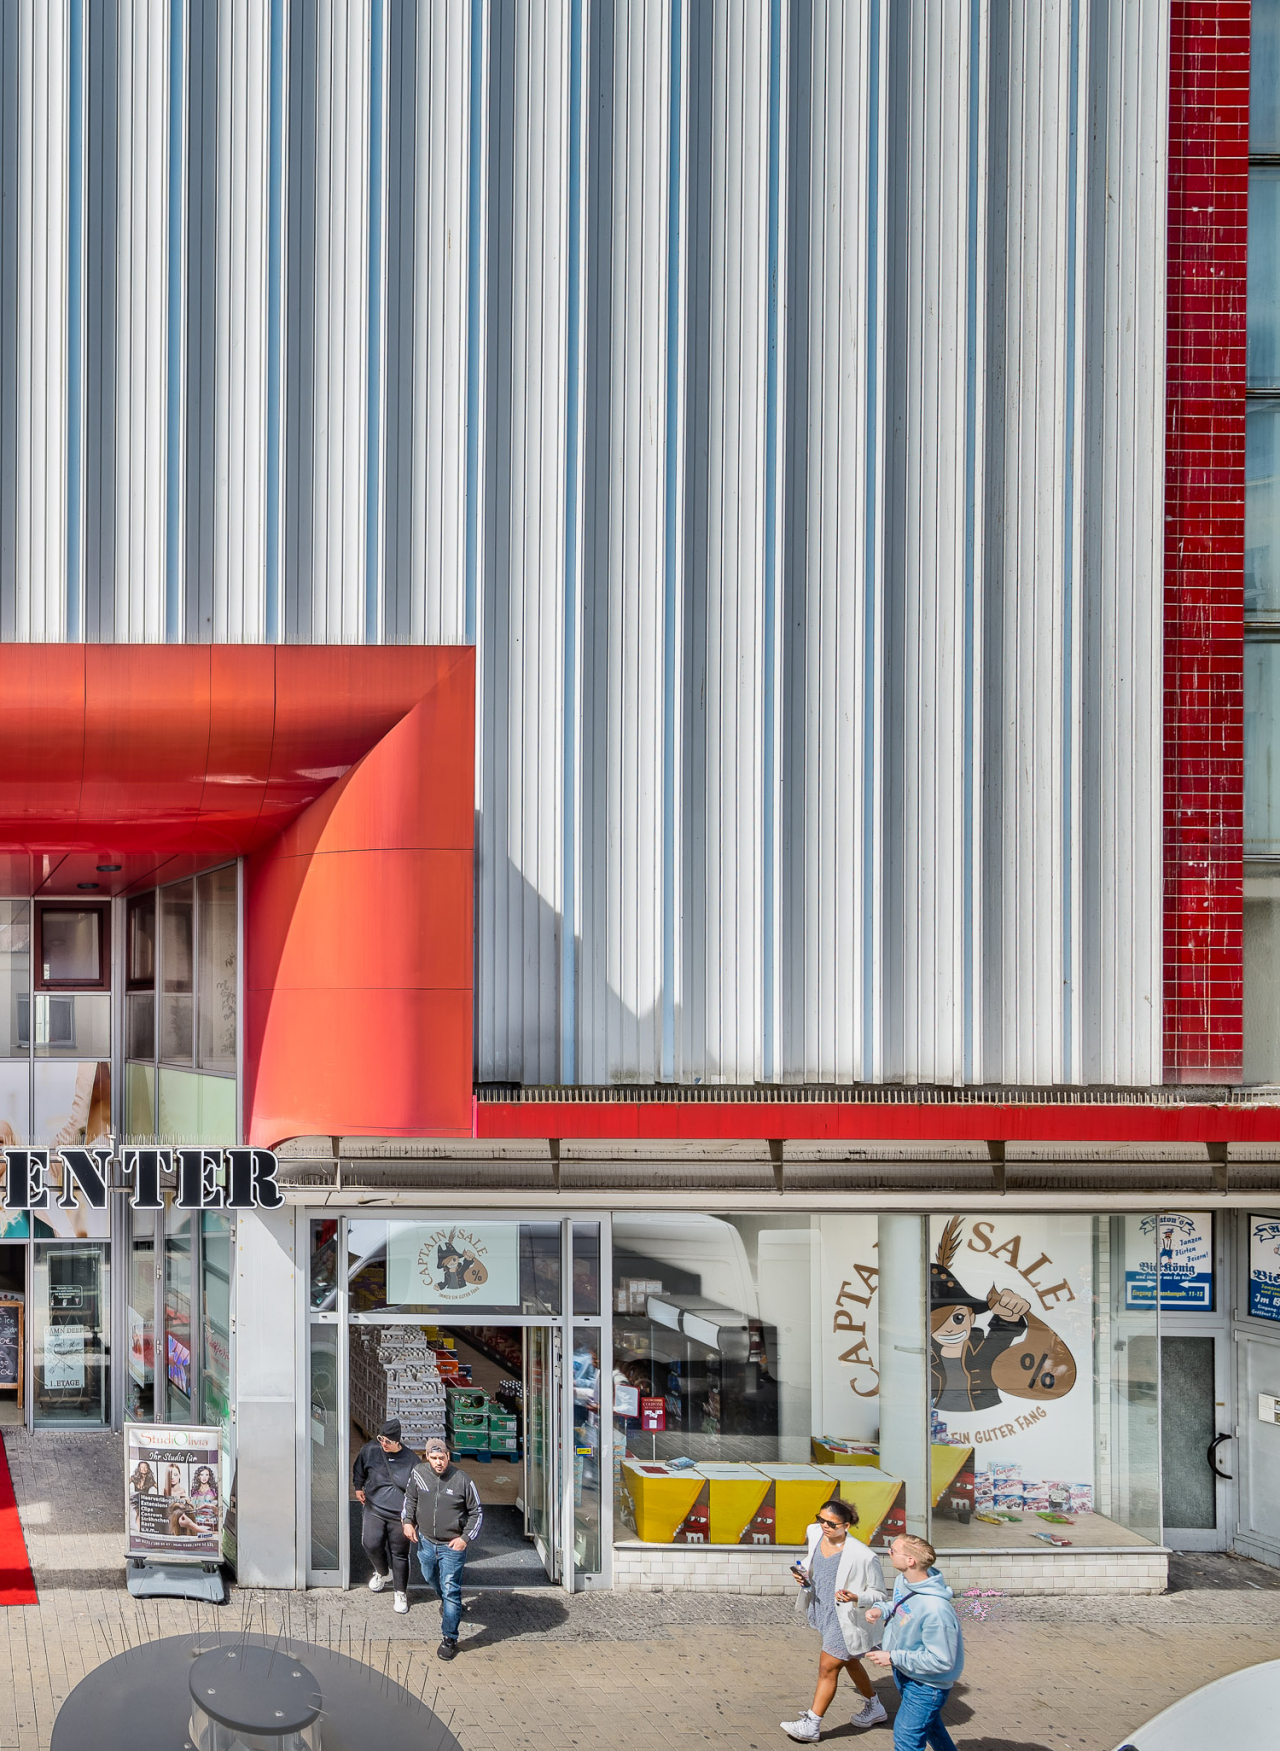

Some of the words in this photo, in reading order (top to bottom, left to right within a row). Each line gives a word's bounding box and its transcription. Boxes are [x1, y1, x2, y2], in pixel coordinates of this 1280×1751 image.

[418, 1229, 447, 1286] CAPTAIN
[457, 1228, 488, 1257] SALE
[967, 1221, 1076, 1311] SALE
[833, 1241, 879, 1398] CAPTA
[974, 1423, 1016, 1444] GUTER
[1015, 1406, 1047, 1431] FANG
[149, 1450, 160, 1460] Ihr
[163, 1452, 185, 1462] Studio
[186, 1453, 198, 1464] für
[951, 1498, 970, 1510] m
[686, 1532, 704, 1544] m
[752, 1532, 770, 1544] m
